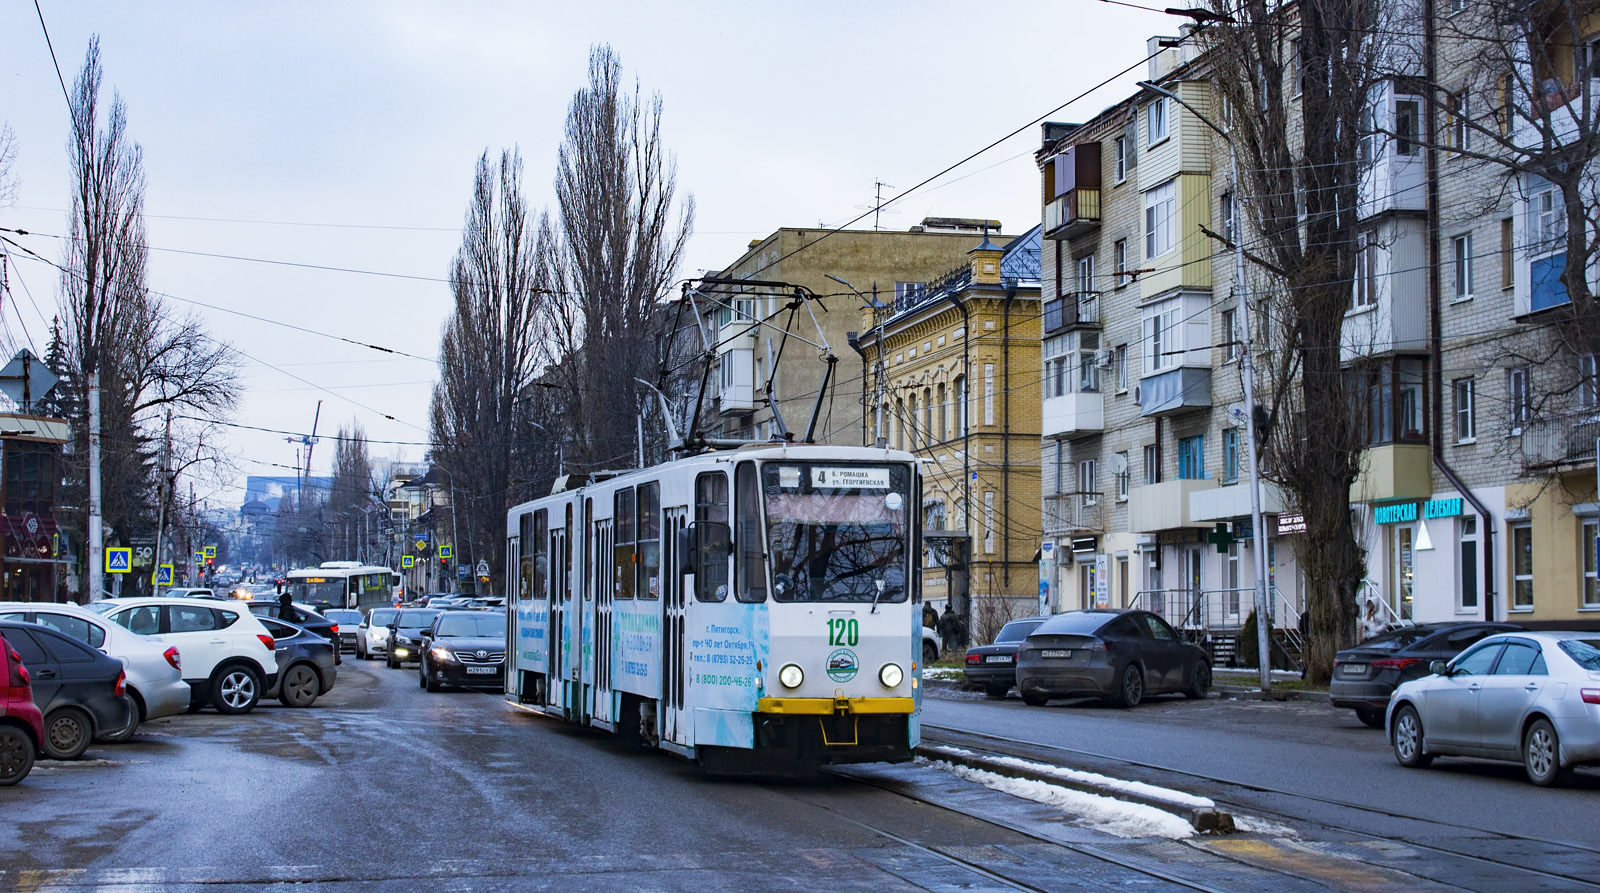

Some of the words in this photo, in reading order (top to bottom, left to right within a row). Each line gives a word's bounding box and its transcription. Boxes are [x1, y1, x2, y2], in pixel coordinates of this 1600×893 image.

[818, 471, 826, 484] 4
[1374, 502, 1417, 525] НОВОТЕРСКАЯ
[1424, 498, 1461, 518] ЦЕЛЕБНАЯ
[711, 624, 740, 635] Пятигорск,
[827, 618, 858, 646] 120
[692, 640, 704, 649] пр-т
[704, 639, 713, 648] 40
[714, 641, 723, 649] лет
[706, 654, 711, 663] 8
[711, 654, 729, 664] (8793)
[729, 655, 753, 665] 32-25-25
[696, 673, 700, 684] 8
[701, 674, 718, 685] (800)
[719, 675, 752, 687] 200-46-26
